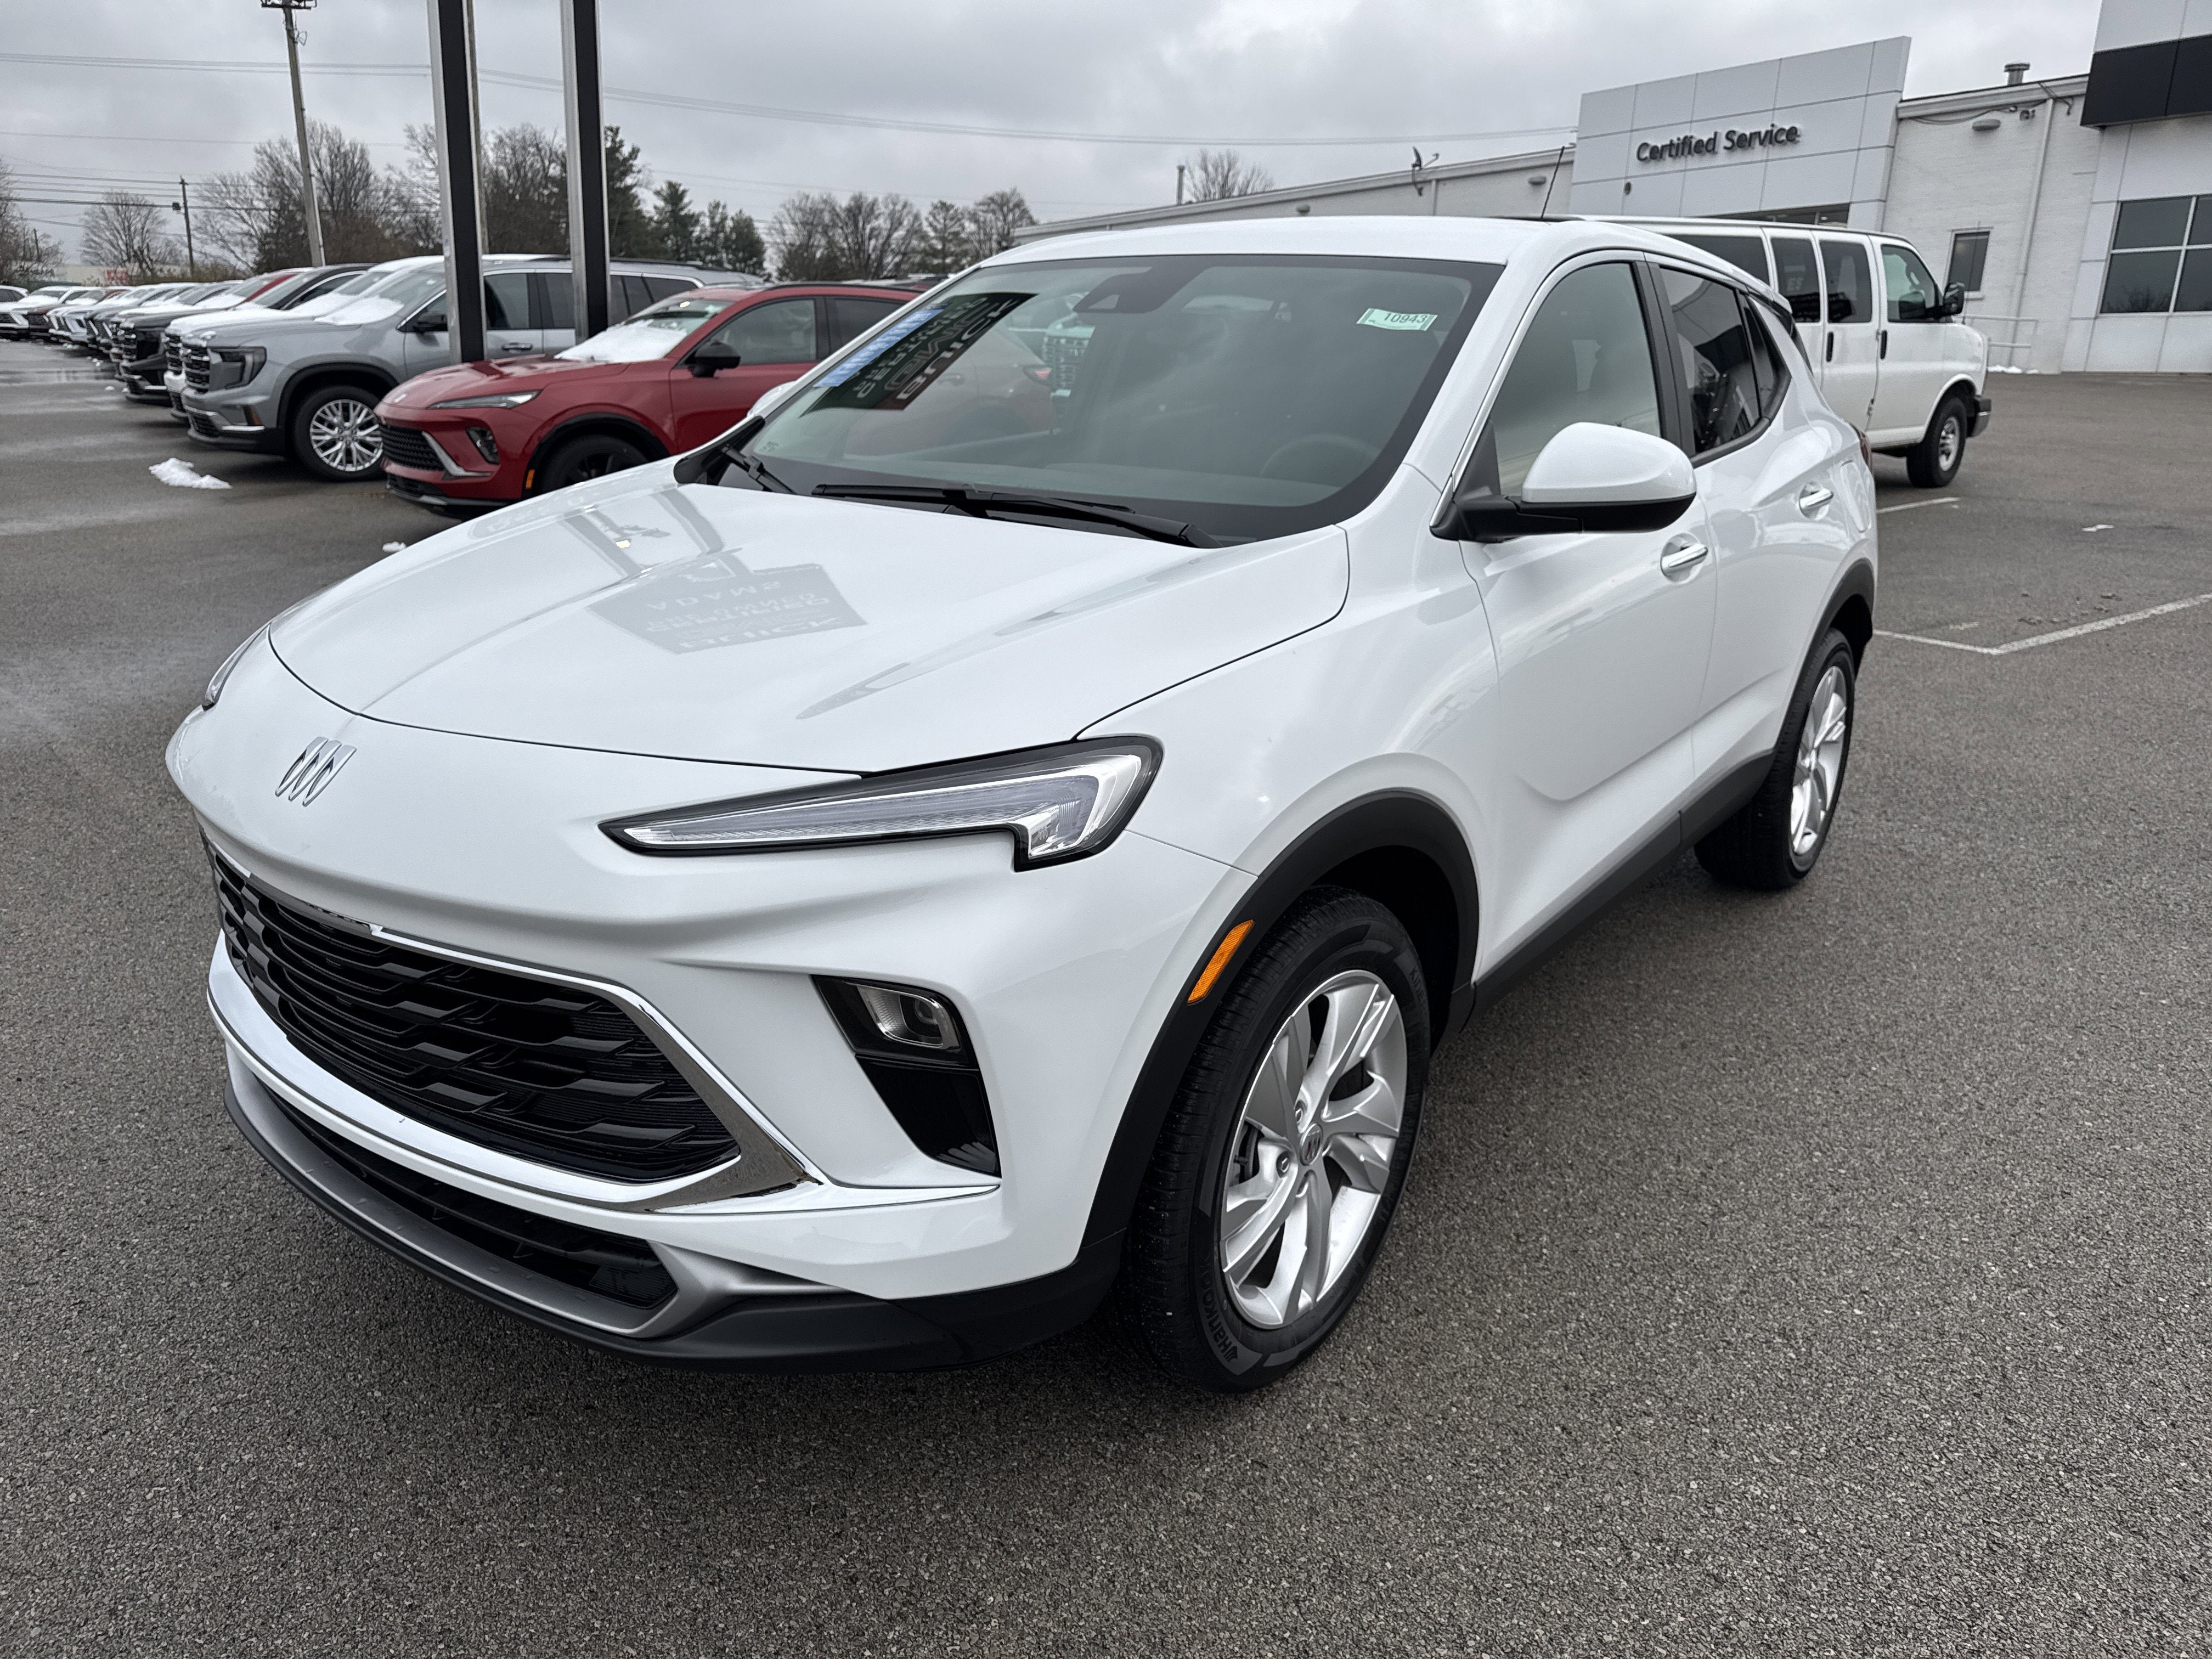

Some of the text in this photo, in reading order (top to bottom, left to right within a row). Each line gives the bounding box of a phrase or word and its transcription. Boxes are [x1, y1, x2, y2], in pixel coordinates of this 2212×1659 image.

[1637, 123, 1799, 161] Certified Service
[1384, 313, 1427, 324] 10943
